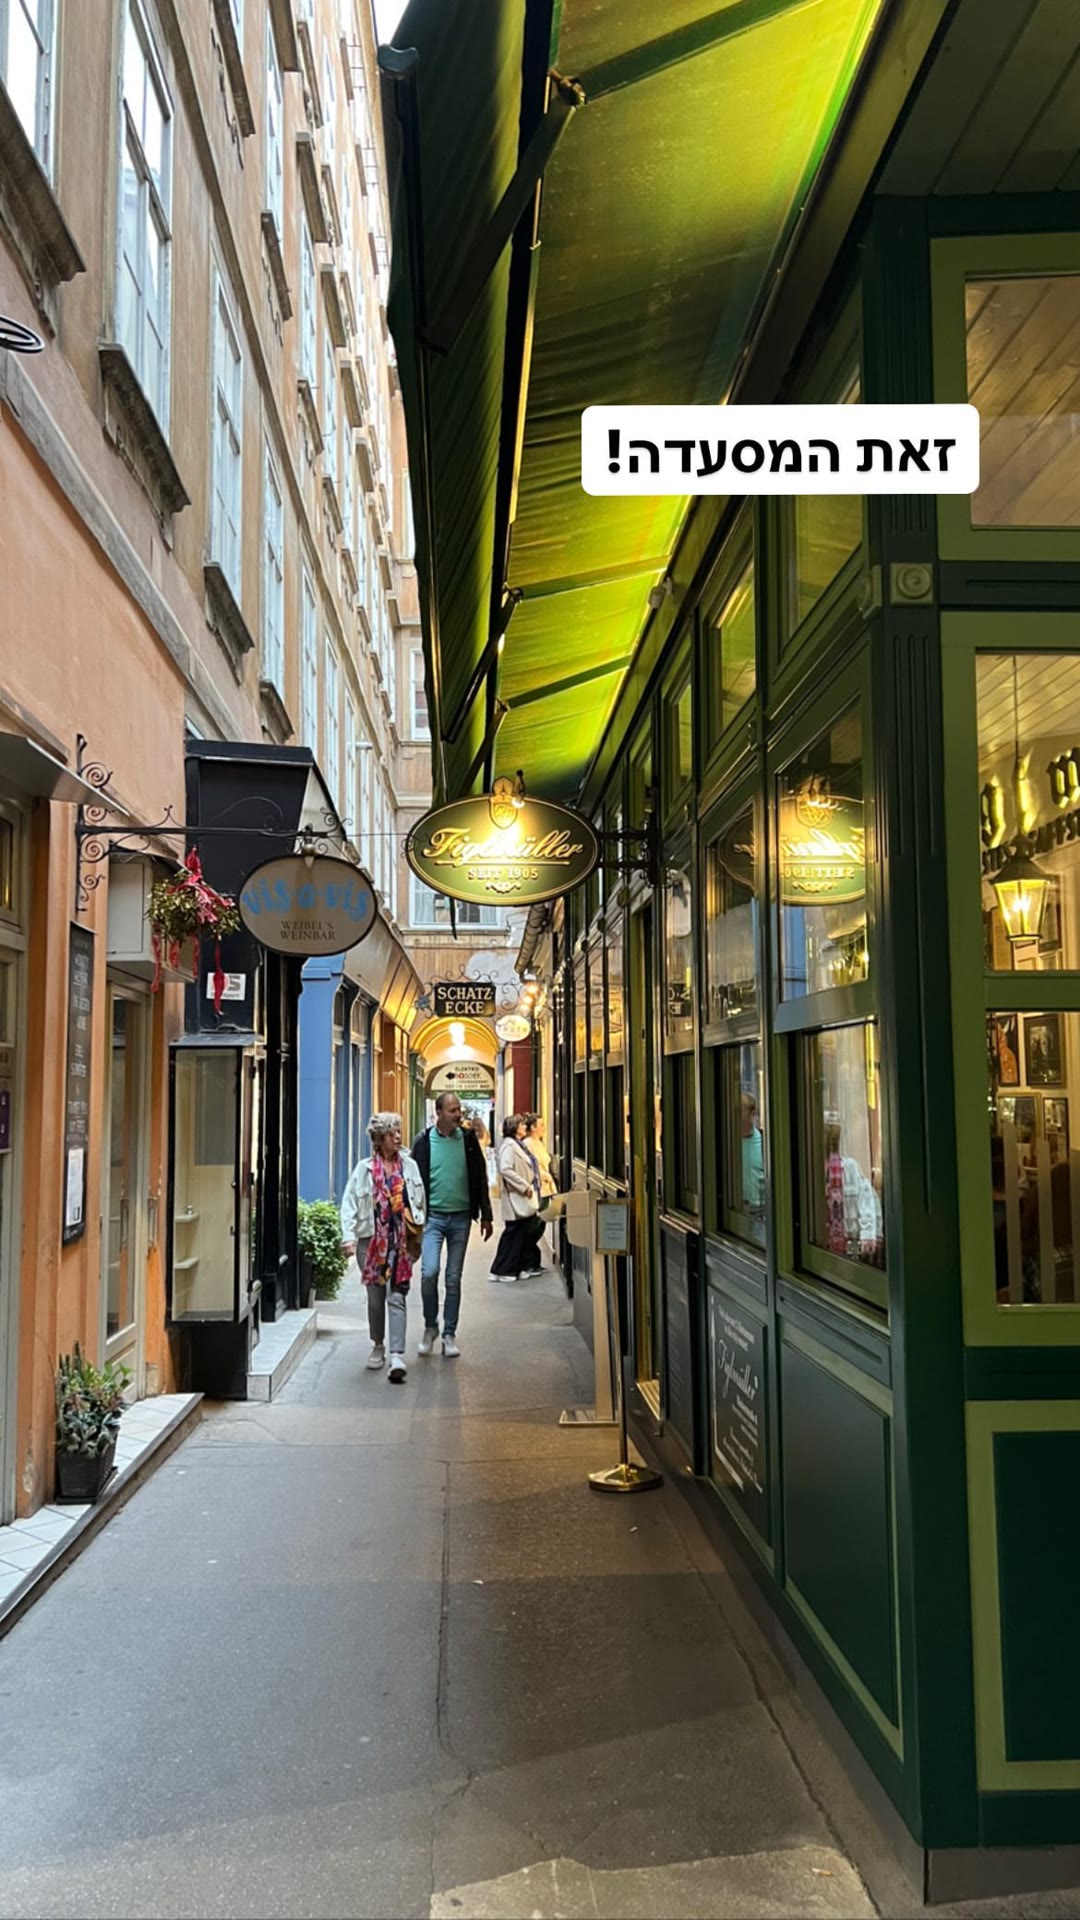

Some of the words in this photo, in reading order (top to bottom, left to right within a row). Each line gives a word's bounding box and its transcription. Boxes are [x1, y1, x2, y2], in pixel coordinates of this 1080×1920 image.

[422, 827, 584, 868] Figüller
[468, 868, 502, 880] SEIT
[507, 868, 539, 880] 1905
[281, 920, 334, 930] WEIBEL'S
[280, 930, 336, 941] WEINBAR
[444, 1001, 485, 1014] ECKE
